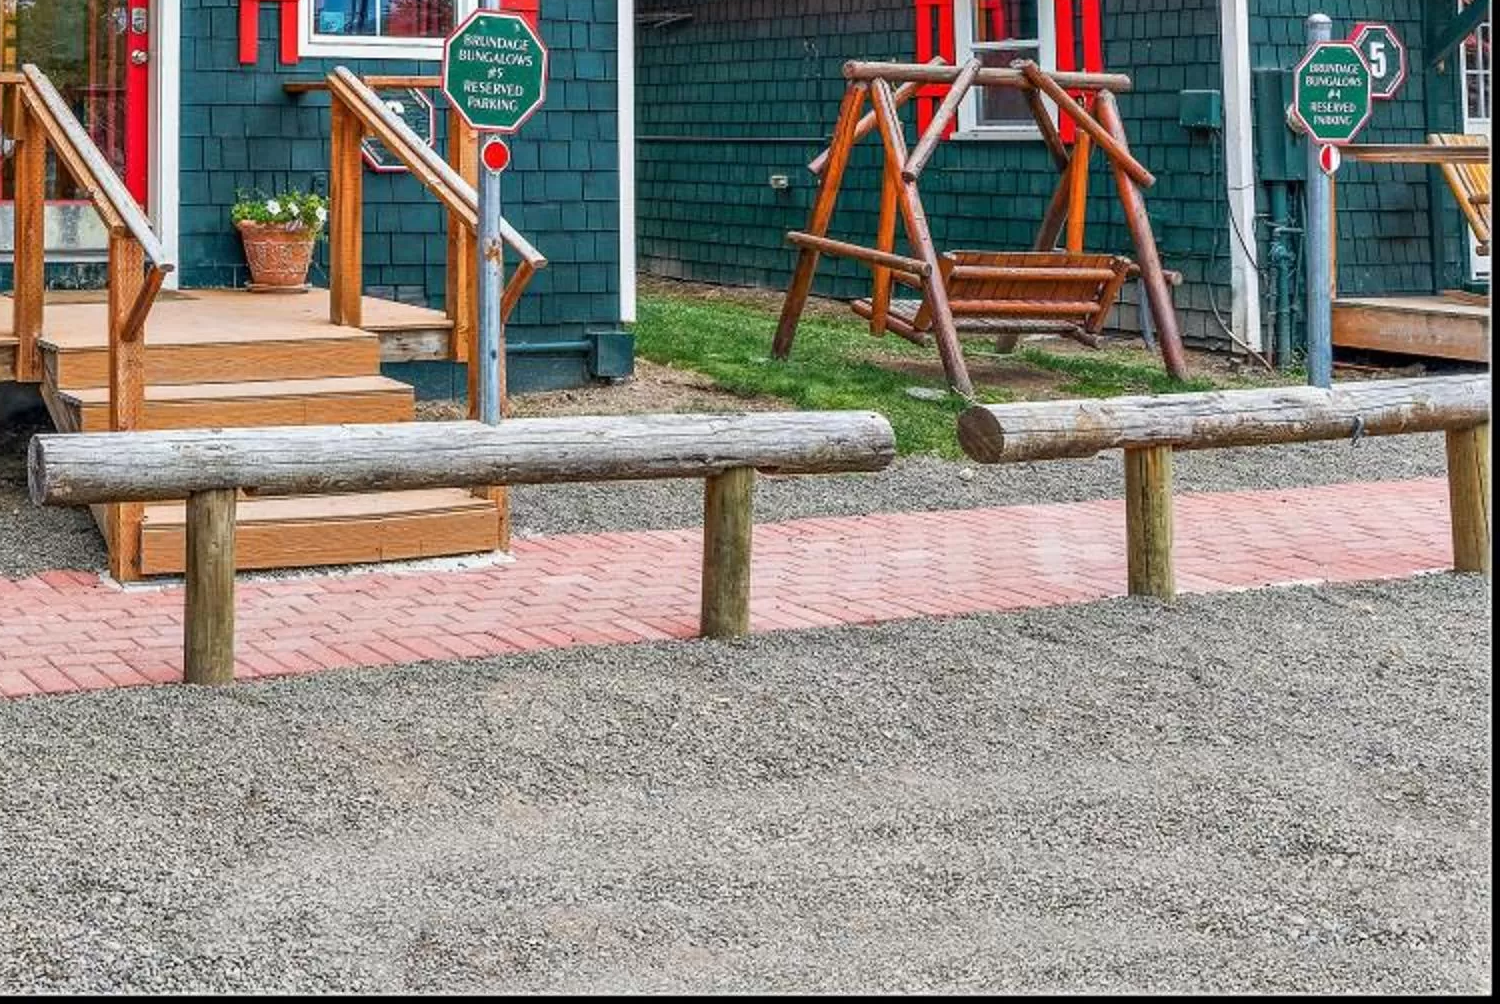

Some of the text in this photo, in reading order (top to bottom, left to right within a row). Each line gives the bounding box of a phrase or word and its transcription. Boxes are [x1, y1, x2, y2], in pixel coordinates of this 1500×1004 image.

[463, 34, 529, 52] BRUNDAGE
[458, 49, 533, 67] BUNGALOWS
[1369, 41, 1387, 79] 5
[487, 67, 504, 79] #5
[463, 80, 525, 97] RESERVED
[467, 96, 518, 112] PARKING
